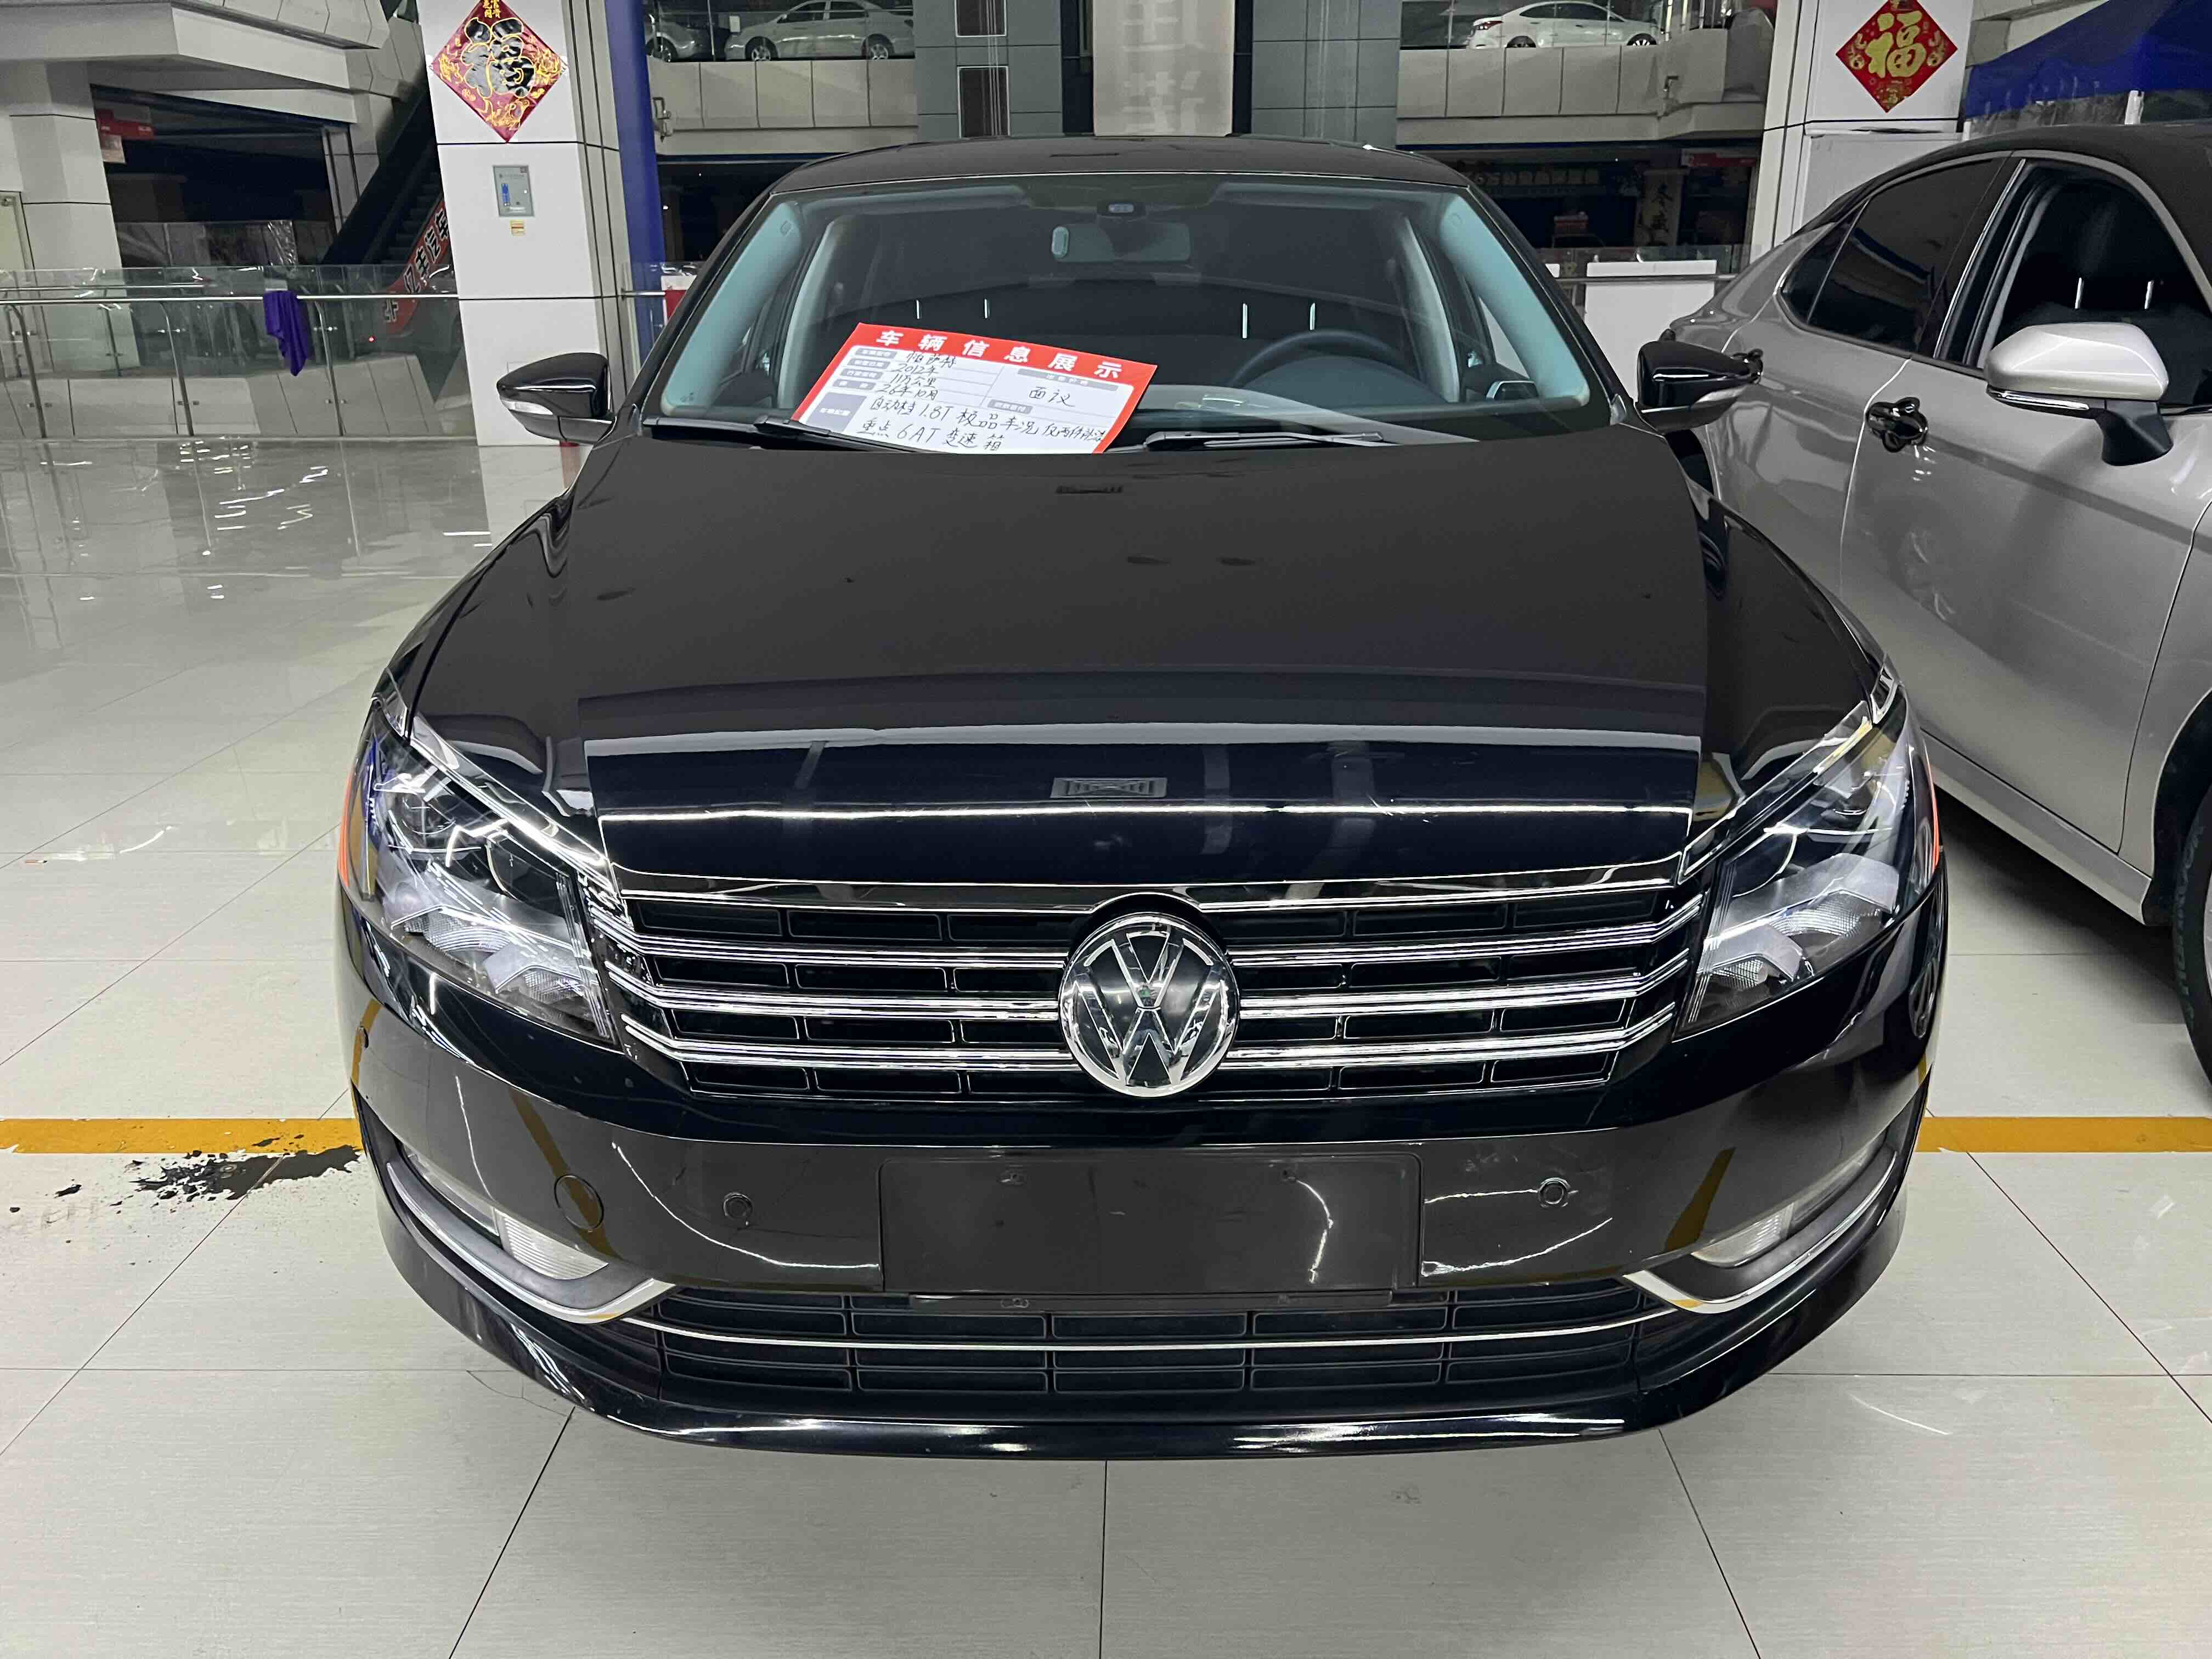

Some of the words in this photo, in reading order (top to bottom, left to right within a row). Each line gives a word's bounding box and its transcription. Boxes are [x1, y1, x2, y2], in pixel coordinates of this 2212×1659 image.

[1865, 10, 1927, 79] 福
[876, 330, 1122, 379] 车辆信息展示
[906, 351, 956, 368] 帕萨特
[889, 363, 939, 375] 2012年
[1029, 386, 1075, 407] 面议
[919, 403, 955, 421] 1.8T
[897, 423, 941, 443] 6AT
[943, 428, 1005, 451] 变速箱
